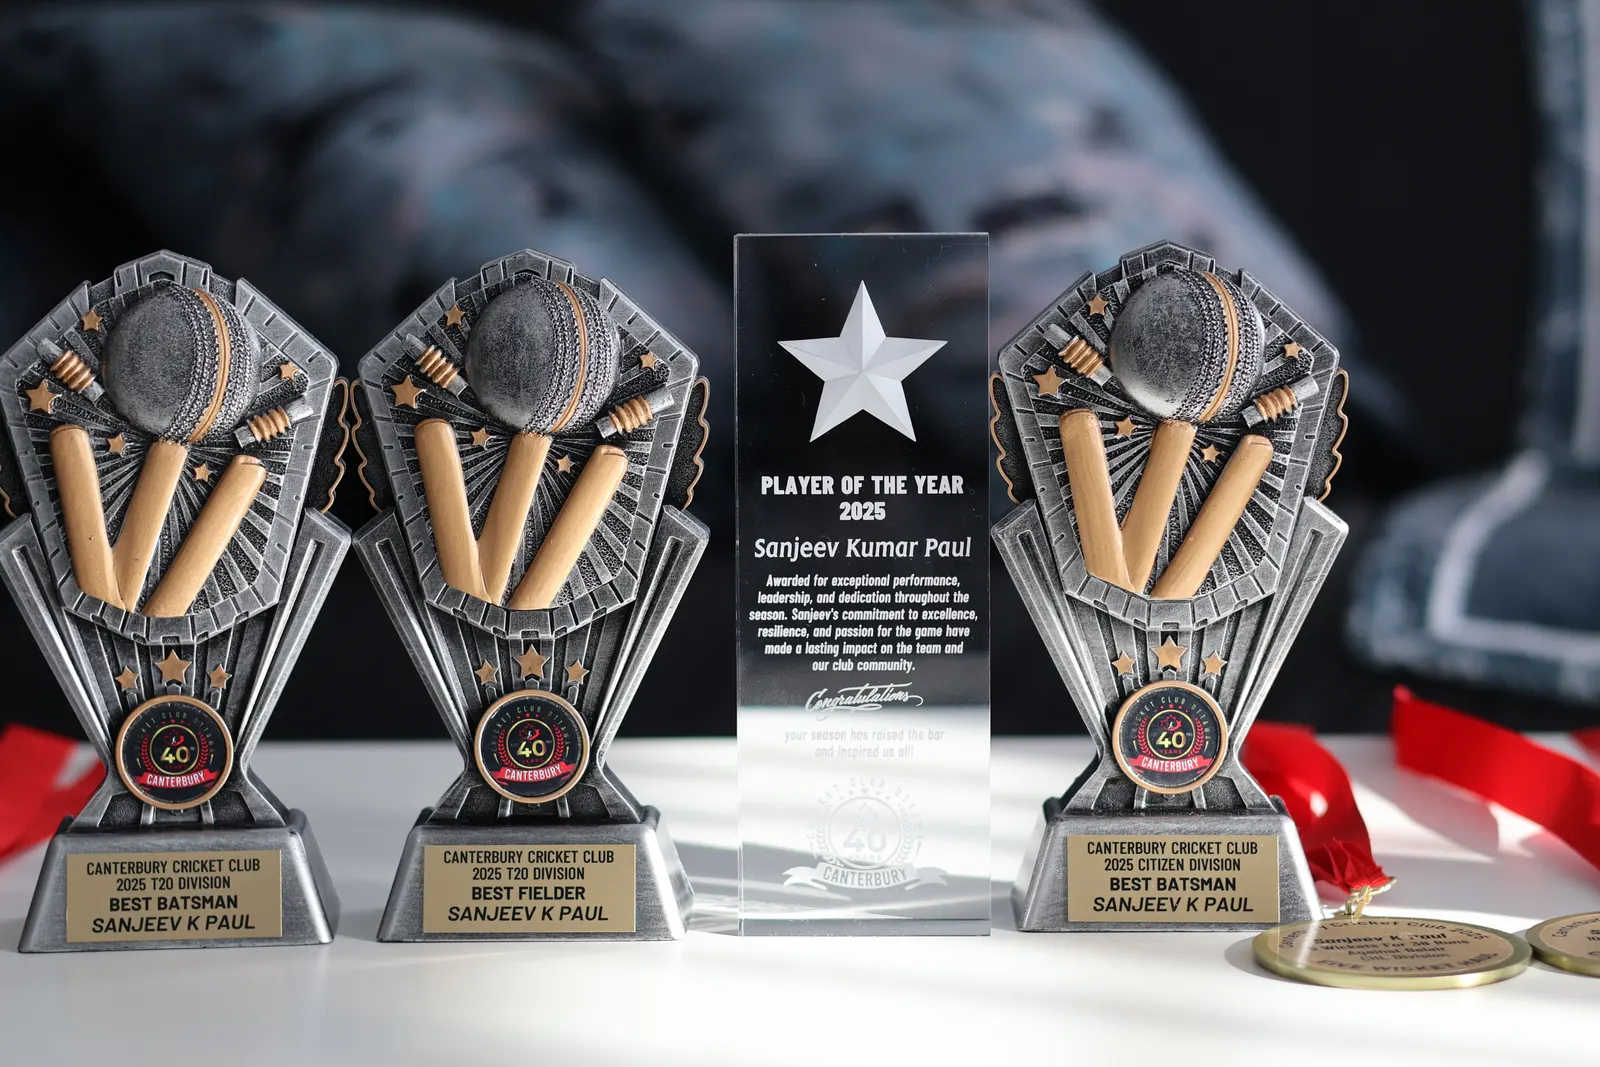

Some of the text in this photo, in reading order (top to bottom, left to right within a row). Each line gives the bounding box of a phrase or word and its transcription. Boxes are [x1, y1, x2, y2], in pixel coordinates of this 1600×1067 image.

[761, 475, 963, 495] PLAYER OF THE YEAR
[839, 502, 886, 521] 2025
[754, 536, 972, 562] Sanjeev Kumar Paul
[766, 574, 960, 589] Awarded for exceptional performance,
[757, 591, 969, 606] leadership, and dedication throughout the
[749, 608, 978, 623] season. Sanjeev's commitment to excellence,
[758, 625, 970, 640] resilience, and passion for the game have
[765, 642, 963, 657] made a lasting impact on the team and
[812, 659, 915, 674] our club community.
[805, 682, 923, 721] Congratulations
[784, 729, 945, 743] your season has raised the bar
[1156, 731, 1186, 749] 40
[160, 746, 191, 764] 40
[516, 739, 547, 758] 40
[815, 746, 834, 758] and
[838, 745, 879, 760] inspired
[883, 748, 894, 758] us
[504, 764, 562, 780] CANTERBURY
[1141, 757, 1200, 772] CANTERBURY
[146, 772, 206, 787] CANTERBURY
[843, 828, 887, 853] 40
[1087, 842, 1258, 855] CANTERBURY CRICKET CLUB
[444, 850, 614, 864] CANTERBURY CRICKET CLUB
[1104, 858, 1241, 871] 2025 CITIZEN DIVISION
[87, 858, 260, 875] CANTERBURY CRICKET CLUB
[472, 868, 585, 880] 2025 T20 DIVISION
[116, 876, 231, 891] 2025 T20 DIVISION
[822, 866, 907, 886] CANTERBURY
[1110, 877, 1236, 891] BEST BATSMAN
[472, 887, 586, 900] BEST FIELDER
[109, 895, 238, 911] BEST BATSMAN
[1093, 897, 1253, 912] SANJEEV K PAUL
[448, 906, 608, 921] SANJEEV K PAUL
[92, 915, 255, 933] SANJEEV K PAUL
[1407, 921, 1447, 930] Club
[1313, 936, 1383, 945] Sanjeev
[1389, 934, 1403, 942] K
[1320, 943, 1379, 951] Wickets
[1315, 959, 1365, 970] FIVE
[1372, 961, 1455, 972] WICKET
